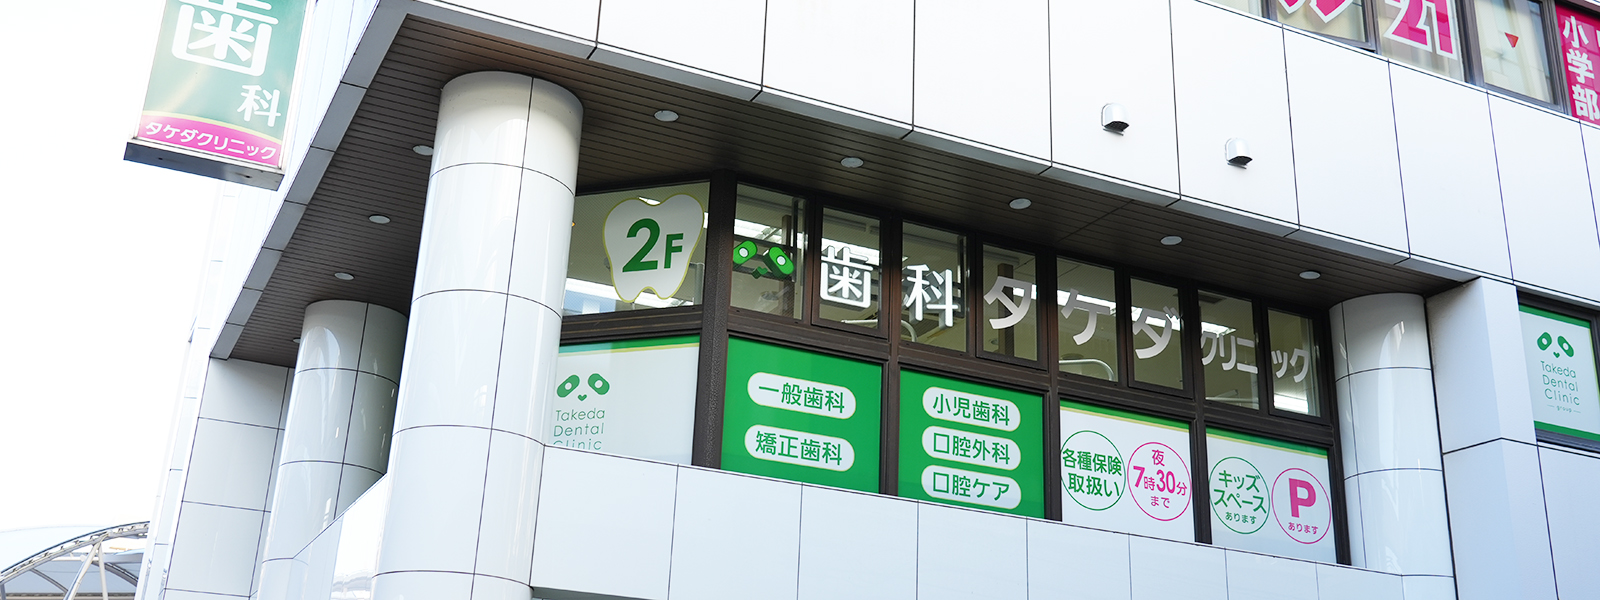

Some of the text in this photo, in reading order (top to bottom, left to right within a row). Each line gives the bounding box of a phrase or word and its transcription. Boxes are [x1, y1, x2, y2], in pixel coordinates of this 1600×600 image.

[1563, 15, 1600, 121] 小学部
[145, 121, 276, 159] タケダクリニック
[622, 218, 684, 273] 2F
[1540, 360, 1577, 379] Takeda
[1542, 374, 1579, 392] Dental
[758, 382, 845, 413] 一般歯科
[932, 393, 1010, 426] 小児歯科
[1544, 388, 1580, 406] Clinic
[556, 408, 605, 421] Takeda
[554, 423, 604, 437] Dental
[755, 430, 842, 465] 矯正歯科
[933, 431, 1010, 465] 口腔外科
[1151, 449, 1166, 467] 夜
[1062, 447, 1122, 476] 各種保険
[933, 471, 1010, 502] 口腔ケア
[1068, 472, 1120, 498] 取扱い
[1133, 465, 1188, 497] 7時30分
[1218, 469, 1260, 493] キッズ
[1150, 495, 1170, 509] まで
[1213, 488, 1267, 514] スペース
[1288, 477, 1317, 519] P
[1225, 511, 1257, 525] あります
[1287, 521, 1319, 535] あります
